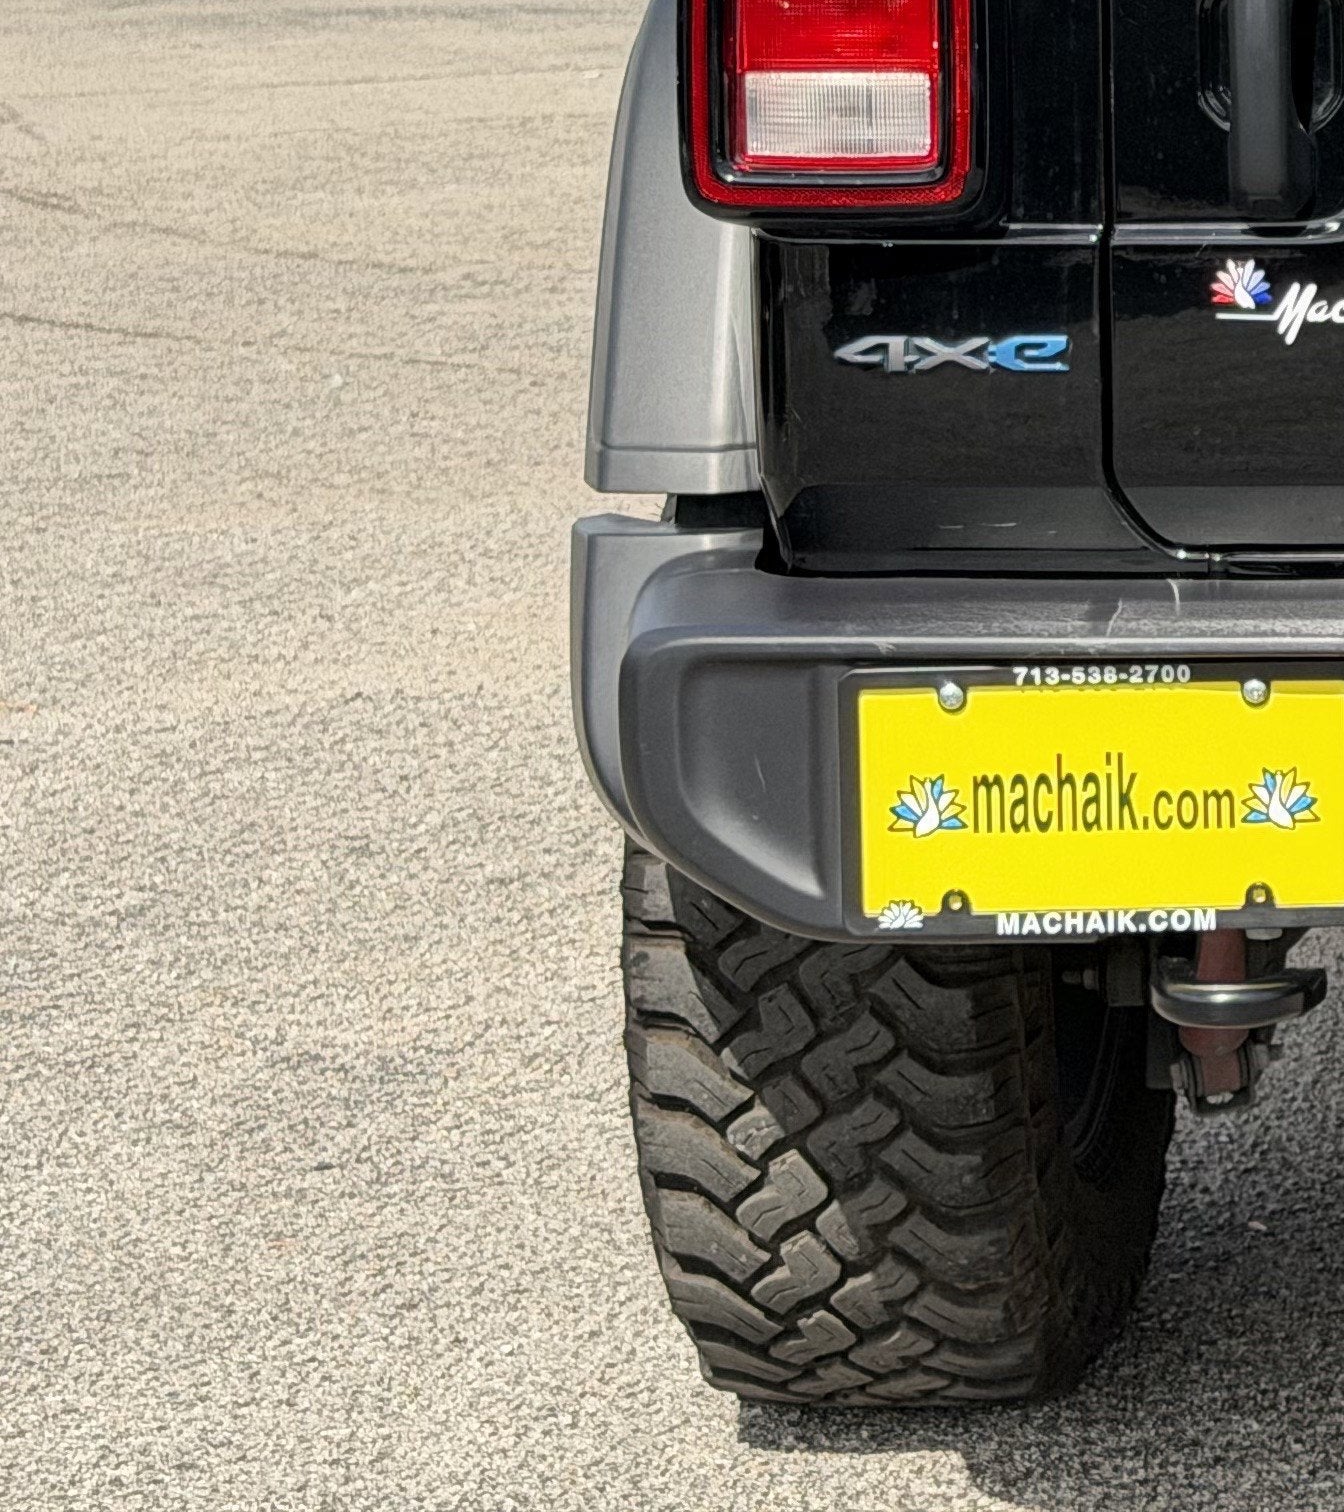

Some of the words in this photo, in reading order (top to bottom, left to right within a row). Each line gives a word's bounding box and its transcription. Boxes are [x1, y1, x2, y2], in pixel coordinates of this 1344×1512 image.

[1012, 664, 1191, 686] 713-538-2700
[971, 751, 1236, 834] machaik.com
[996, 908, 1217, 935] MACHAIK.COM
